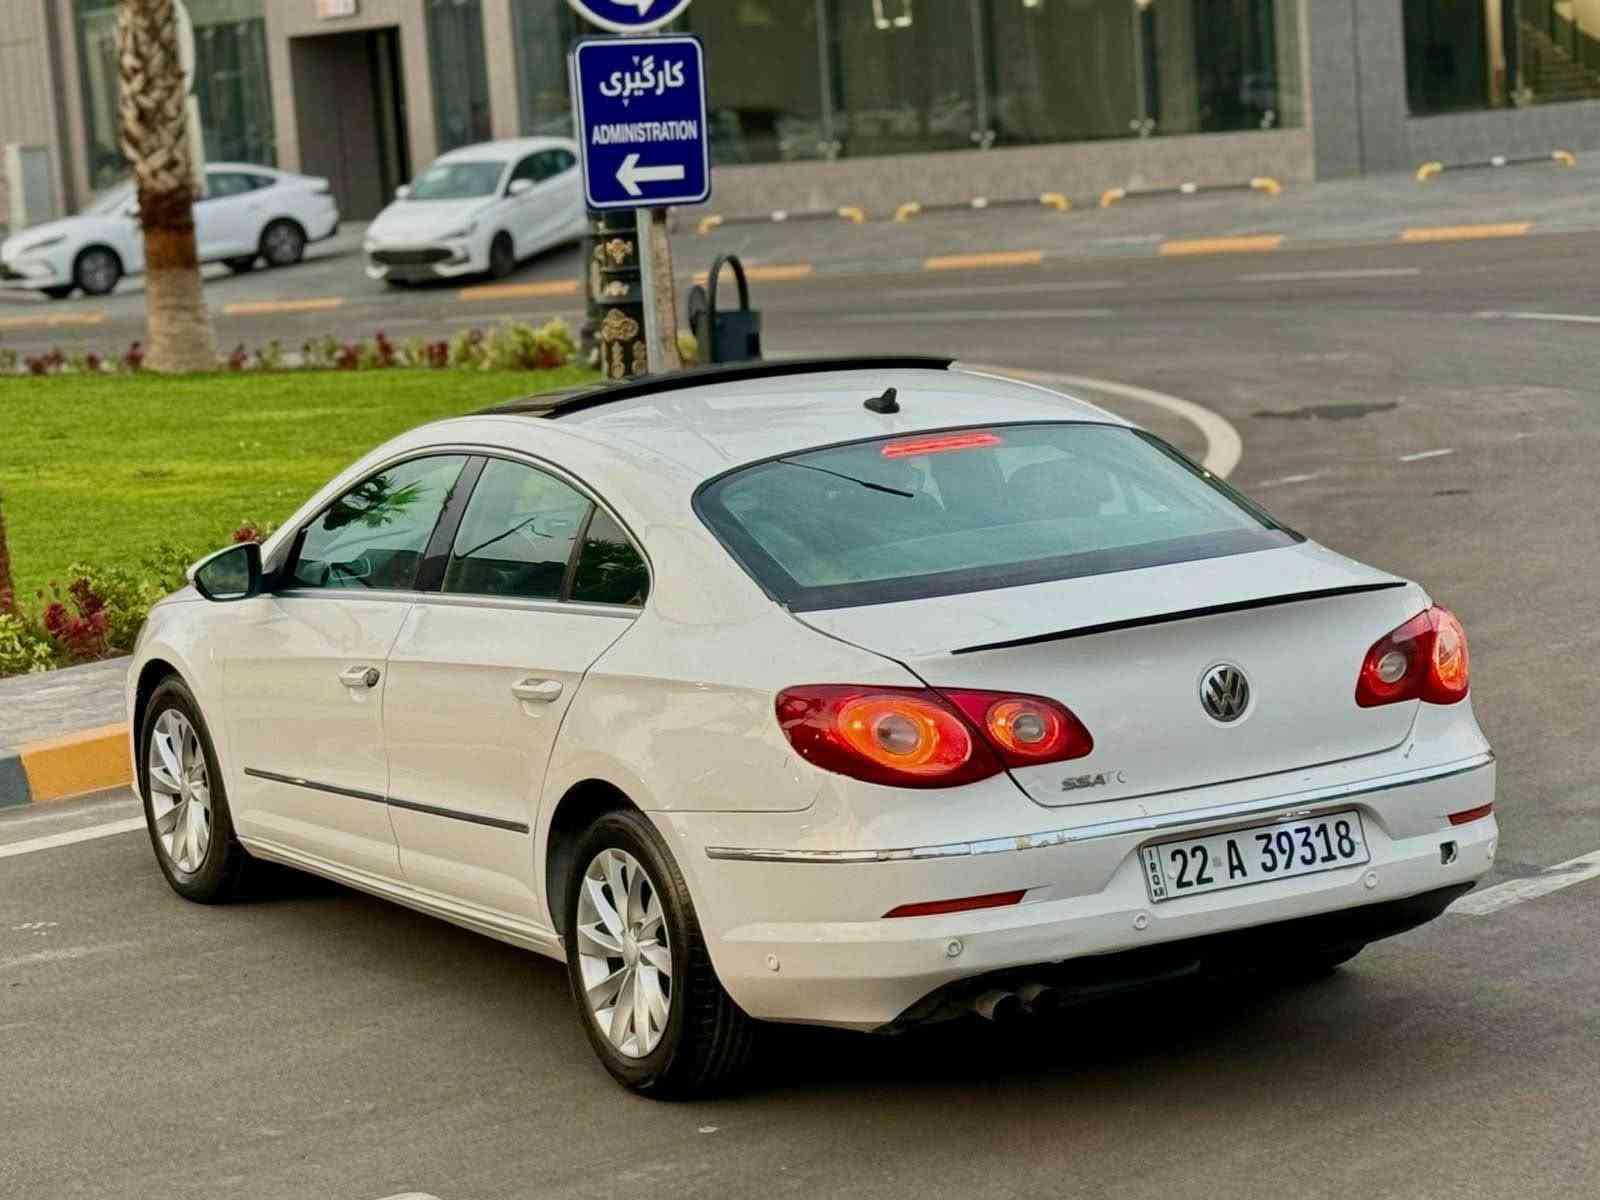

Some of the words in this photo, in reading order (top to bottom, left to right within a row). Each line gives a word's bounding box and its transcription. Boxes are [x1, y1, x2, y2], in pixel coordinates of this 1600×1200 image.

[591, 119, 699, 145] ADMINISTRATION
[1170, 845, 1214, 889] 22
[1226, 839, 1248, 879] A
[1255, 820, 1356, 873] 39318
